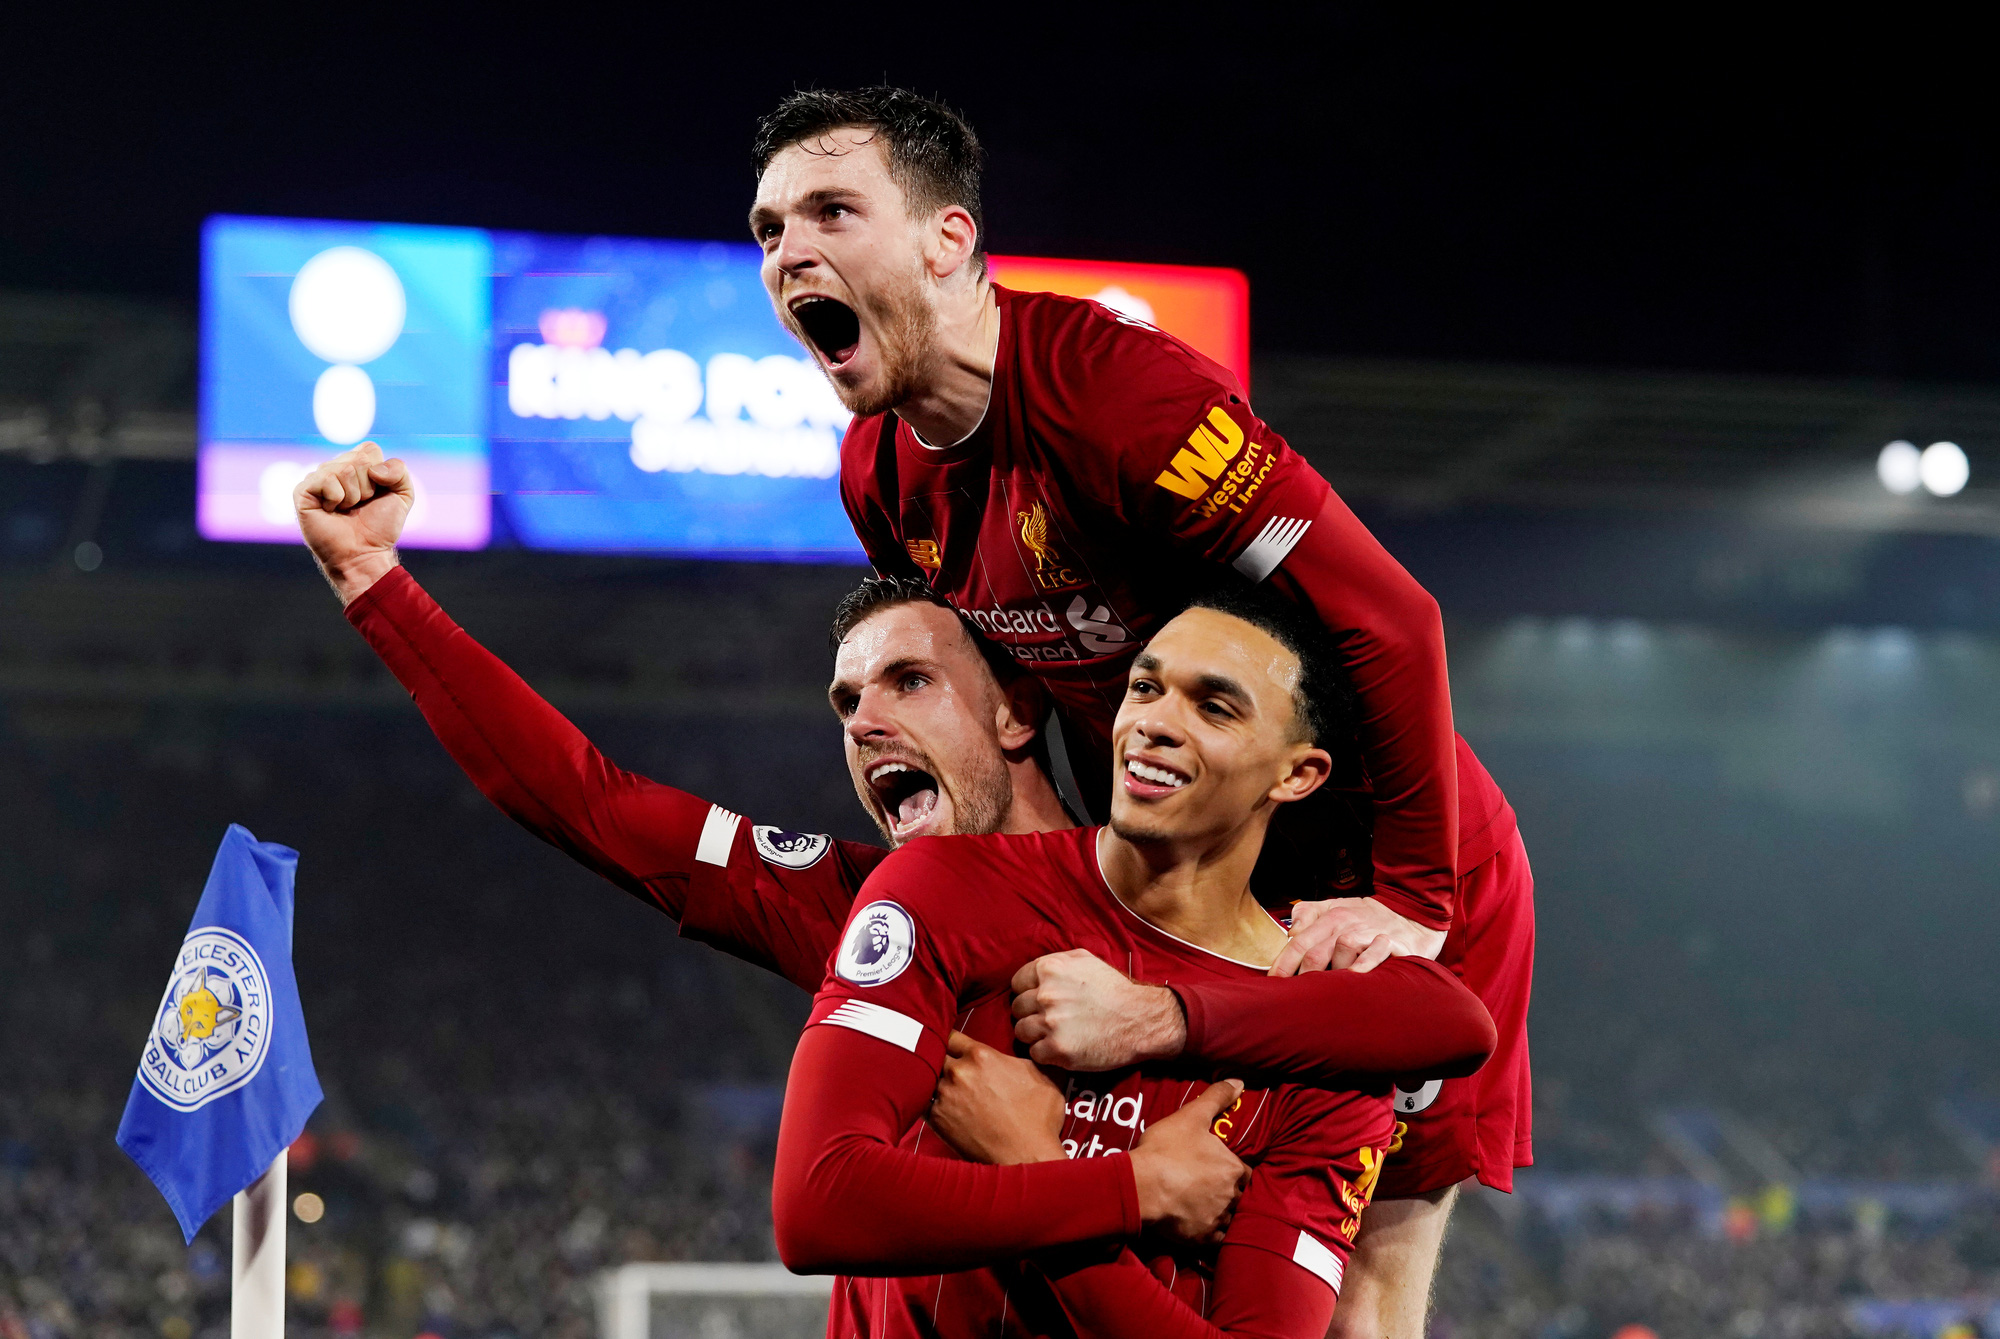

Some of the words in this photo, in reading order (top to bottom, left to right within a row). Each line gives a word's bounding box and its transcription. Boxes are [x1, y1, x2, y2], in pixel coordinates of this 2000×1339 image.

[1154, 405, 1244, 501] WU
[1191, 441, 1262, 519] Western
[958, 601, 1061, 634] andard
[855, 968, 884, 978] Premier
[883, 945, 903, 971] League
[236, 1014, 261, 1064] CITY
[183, 1063, 228, 1094] CLUB
